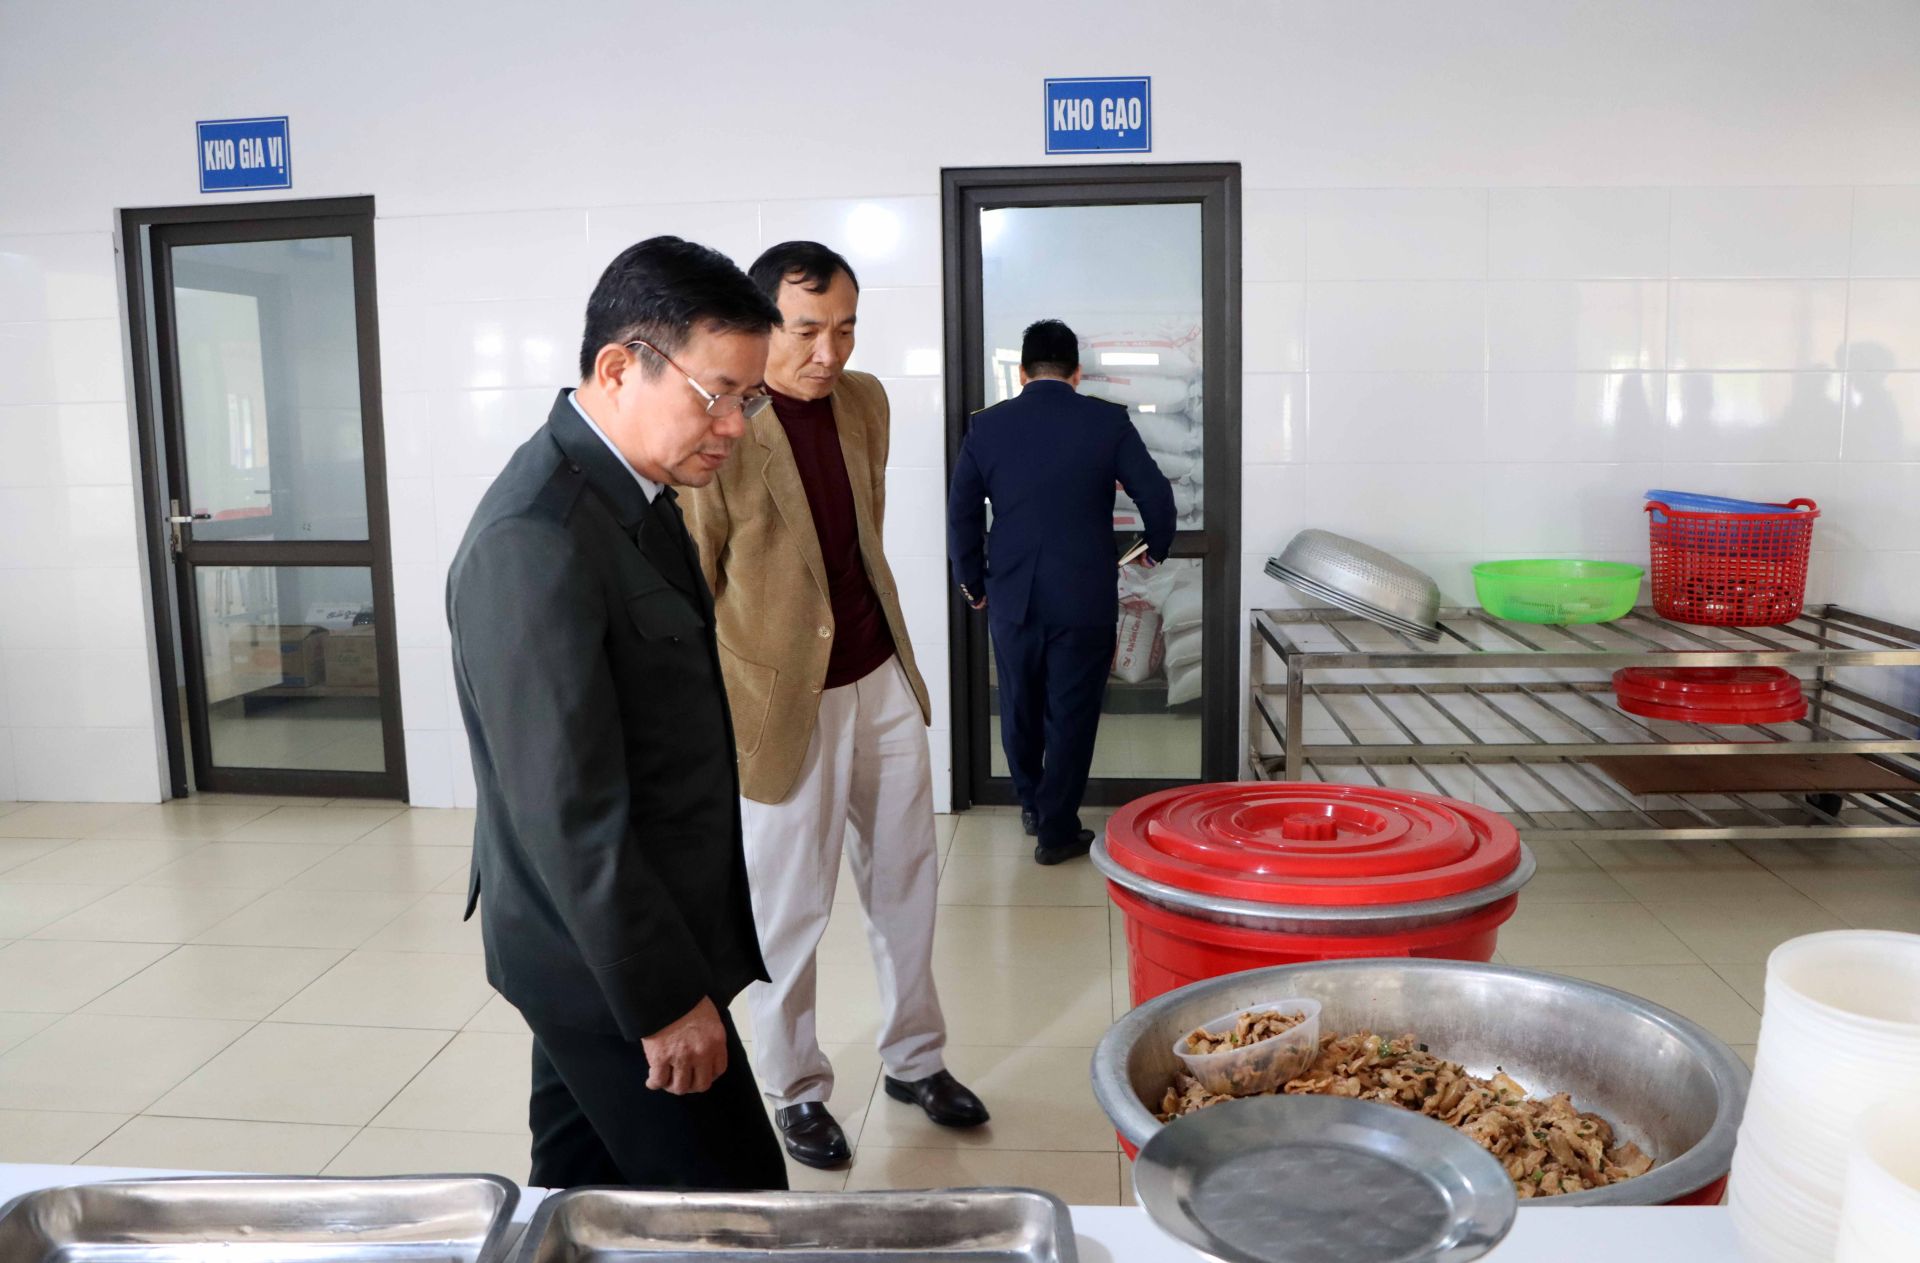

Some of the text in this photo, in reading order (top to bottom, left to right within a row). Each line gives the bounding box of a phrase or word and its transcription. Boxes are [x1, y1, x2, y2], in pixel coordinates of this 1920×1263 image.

[1053, 97, 1142, 137] KHO GẠO
[204, 136, 284, 174] KHO GIA VỊ
